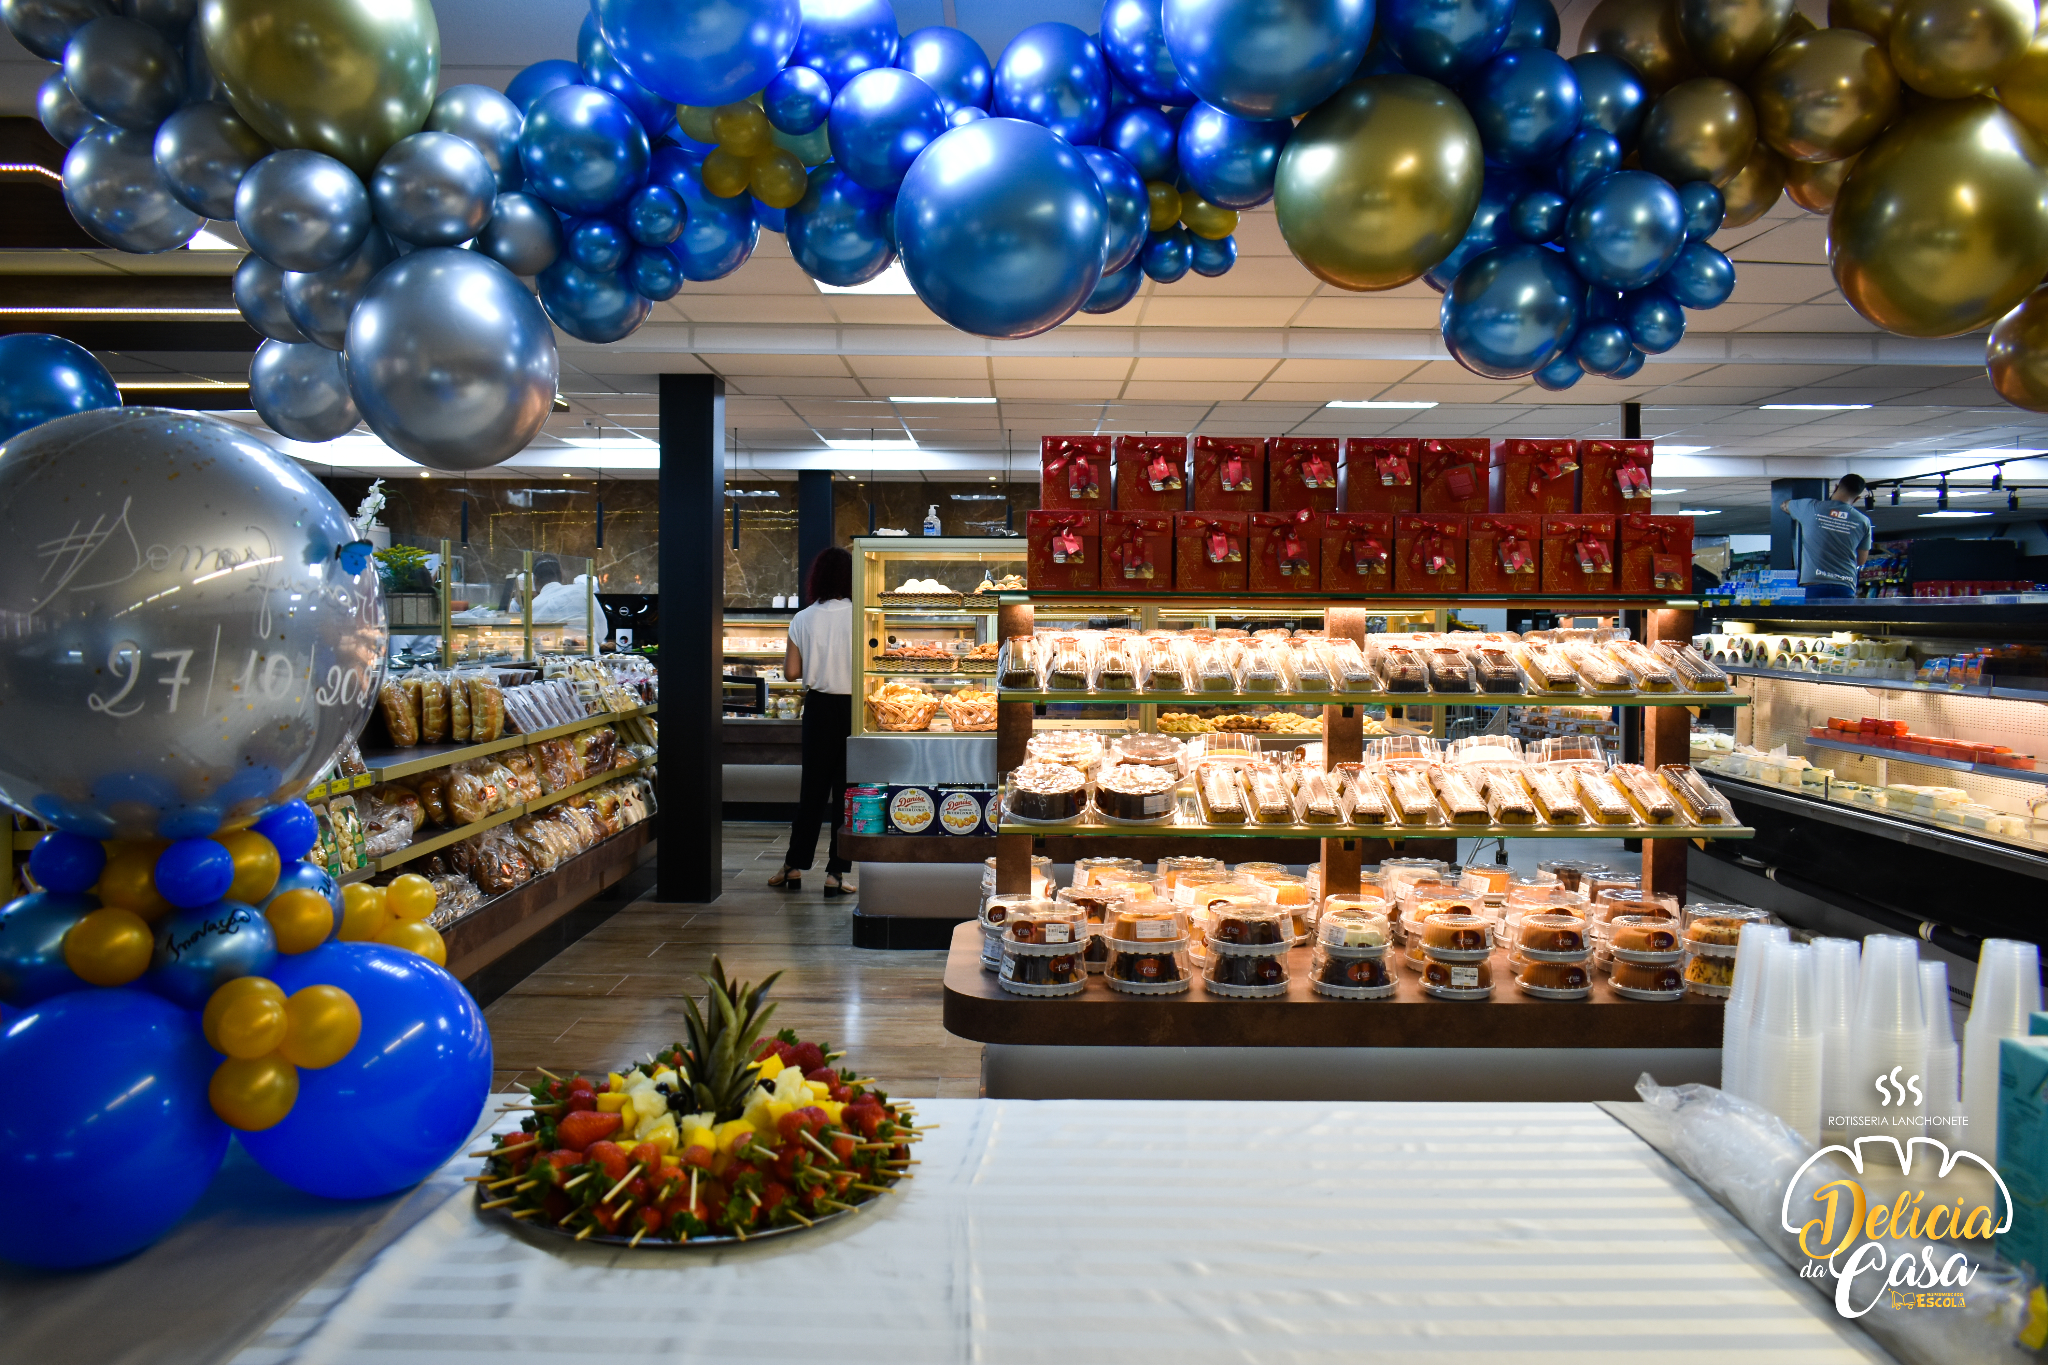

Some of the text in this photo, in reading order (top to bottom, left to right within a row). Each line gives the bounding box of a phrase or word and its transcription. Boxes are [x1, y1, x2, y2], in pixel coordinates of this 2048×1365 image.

[897, 795, 925, 807] Danisa
[945, 799, 972, 811] Danisa
[166, 908, 250, 962] Inovação
